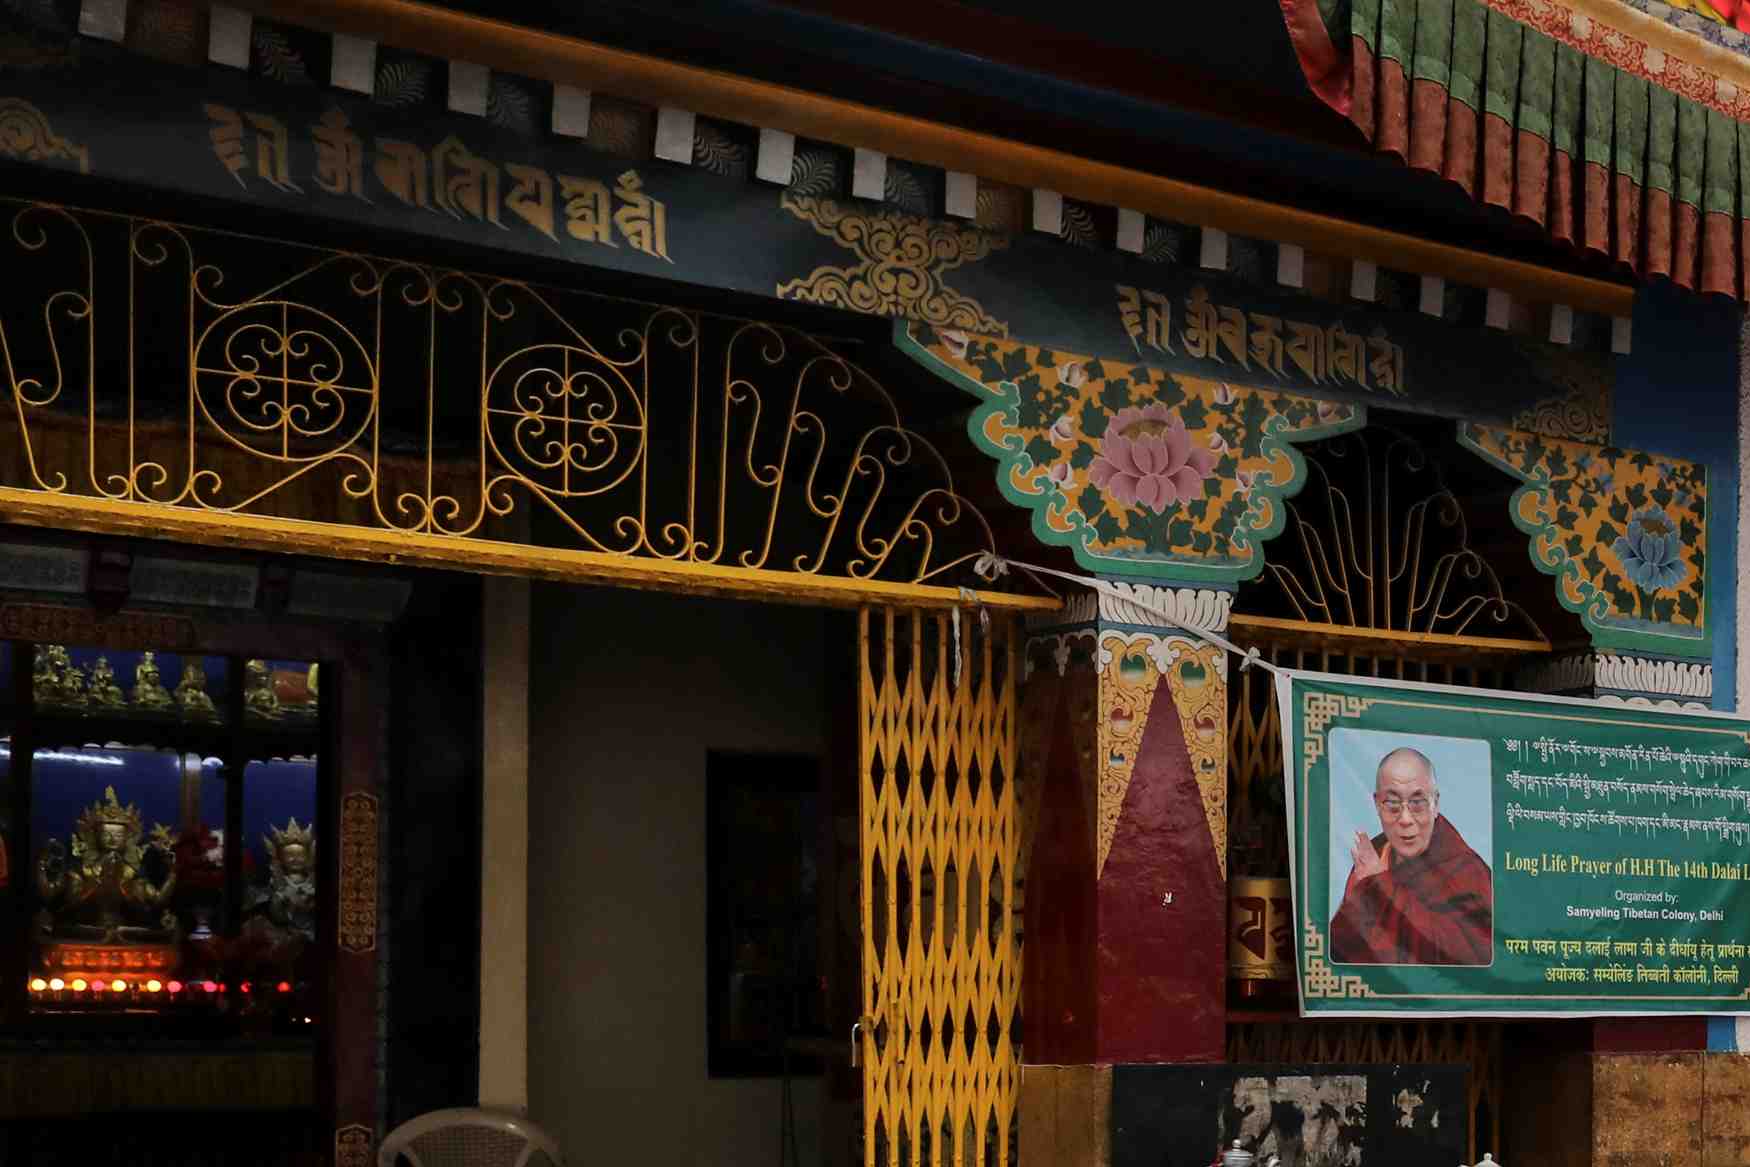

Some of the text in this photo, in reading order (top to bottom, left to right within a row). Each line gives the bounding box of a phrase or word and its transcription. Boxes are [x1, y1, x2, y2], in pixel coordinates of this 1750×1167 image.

[1505, 851, 1538, 877] Long
[1541, 853, 1567, 873] Life
[1571, 855, 1612, 879] Prayer
[1615, 857, 1629, 876] of
[1631, 858, 1655, 877] H.H
[1656, 859, 1680, 878] The
[1684, 861, 1709, 879] 14th
[1711, 861, 1740, 880] Dalai
[1615, 889, 1663, 903] Organized
[1566, 905, 1724, 922] Samyeling Tibetan Colony, Delhi
[1505, 939, 1528, 954] परम
[1585, 936, 1611, 957] दलाई
[1613, 942, 1637, 957] लामा
[1641, 937, 1653, 957] जी
[1656, 938, 1665, 956] के
[1713, 965, 1739, 984] दिल्ली
